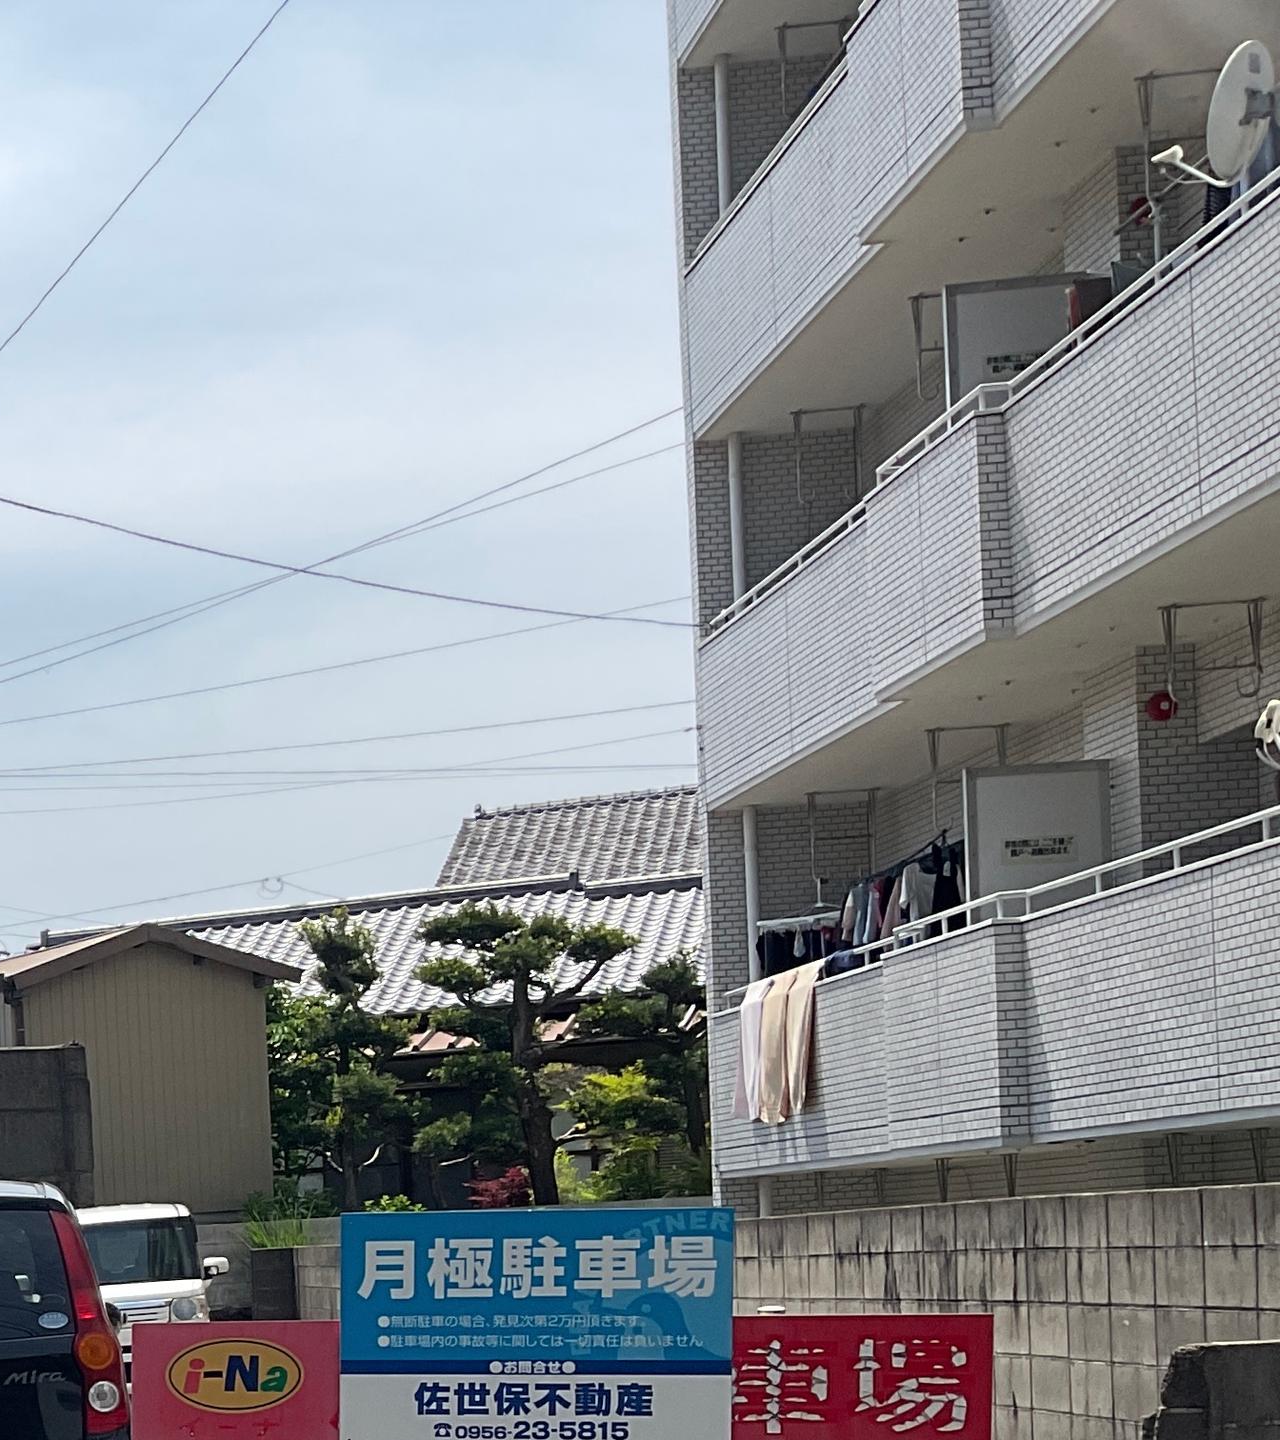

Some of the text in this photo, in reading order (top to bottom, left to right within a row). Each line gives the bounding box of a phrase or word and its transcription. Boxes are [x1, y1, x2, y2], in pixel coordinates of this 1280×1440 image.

[357, 1234, 718, 1300] 月極駐車場
[3, 1369, 67, 1386] Mira
[183, 1355, 289, 1394] i-Na
[502, 1361, 562, 1375] お問合せ
[414, 1382, 654, 1418] 佐世保不動産
